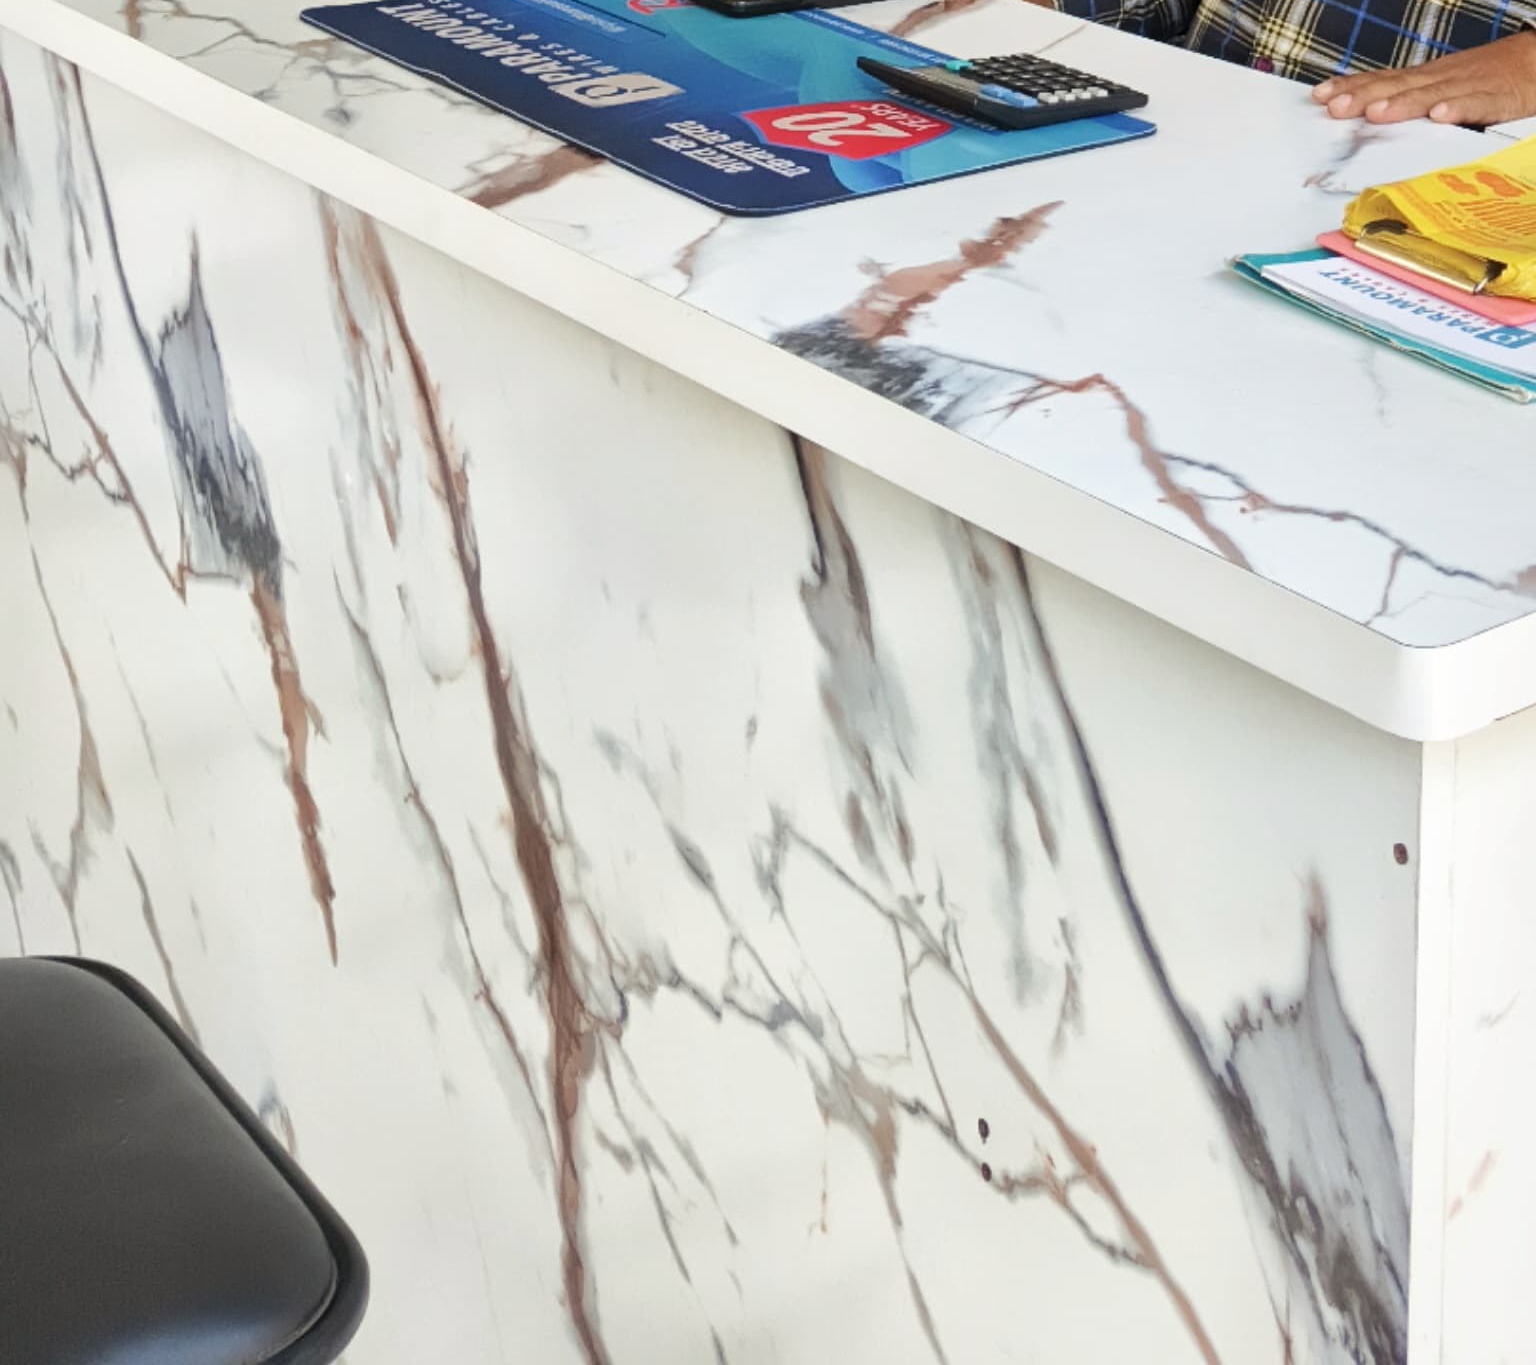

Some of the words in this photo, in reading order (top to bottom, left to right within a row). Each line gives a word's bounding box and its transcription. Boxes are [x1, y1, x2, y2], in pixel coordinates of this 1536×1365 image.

[376, 3, 590, 82] PARAMOUNT
[772, 111, 912, 146] 20
[859, 103, 940, 132] YEARS
[1318, 270, 1484, 335] PARAMOUNT
